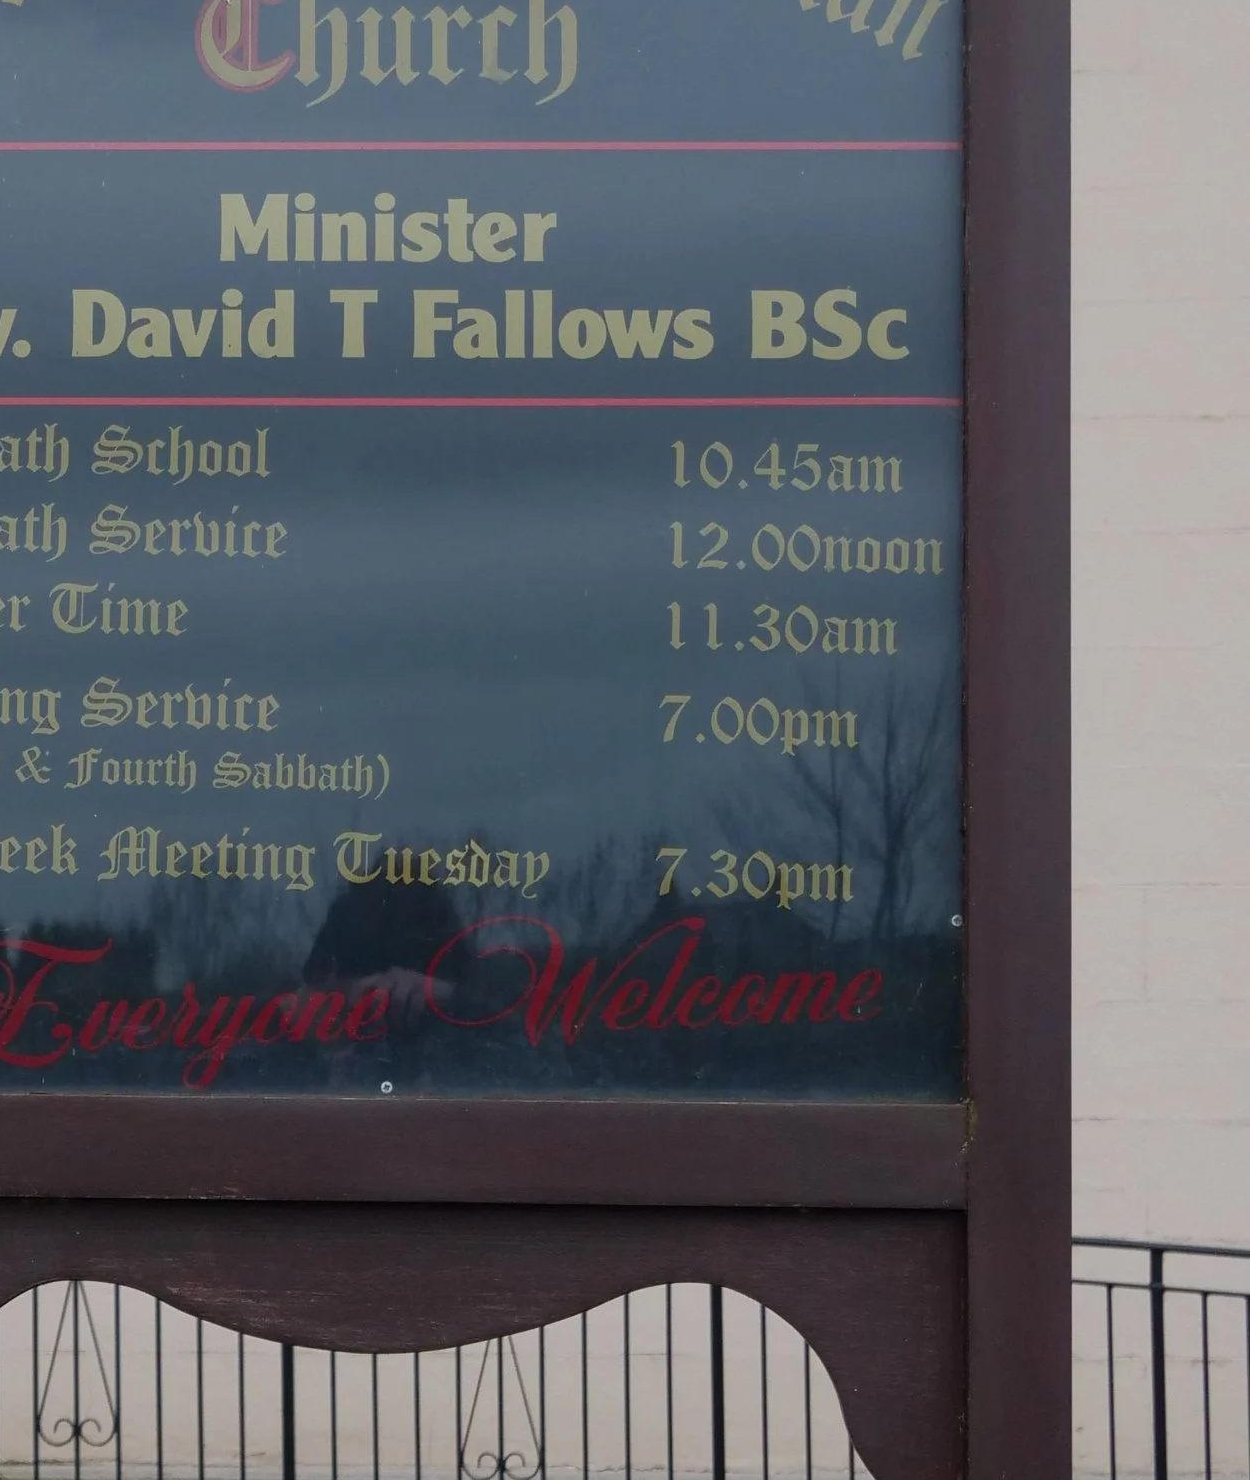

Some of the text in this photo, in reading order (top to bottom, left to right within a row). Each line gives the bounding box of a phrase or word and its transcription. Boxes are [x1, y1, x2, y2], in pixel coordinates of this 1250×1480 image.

[219, 192, 557, 263] Minister
[71, 288, 295, 359] David
[329, 288, 377, 358] T
[411, 288, 714, 360] Fallows
[750, 285, 911, 361] BSc
[91, 424, 272, 486] School
[670, 440, 903, 493] 10.45am
[89, 503, 288, 558] Service
[670, 521, 944, 575] 12.00noon
[49, 582, 190, 636] Time
[667, 601, 899, 656] 11.30am
[80, 675, 280, 732] Service
[658, 694, 858, 756] 7.00pm
[14, 745, 51, 784] &
[63, 747, 197, 794] Fourth
[212, 750, 390, 801] Sabbath)
[97, 825, 315, 892] Meeting
[333, 831, 551, 899] Tuesday
[655, 847, 855, 910] 7.30pm
[423, 917, 887, 1047] Welcome
